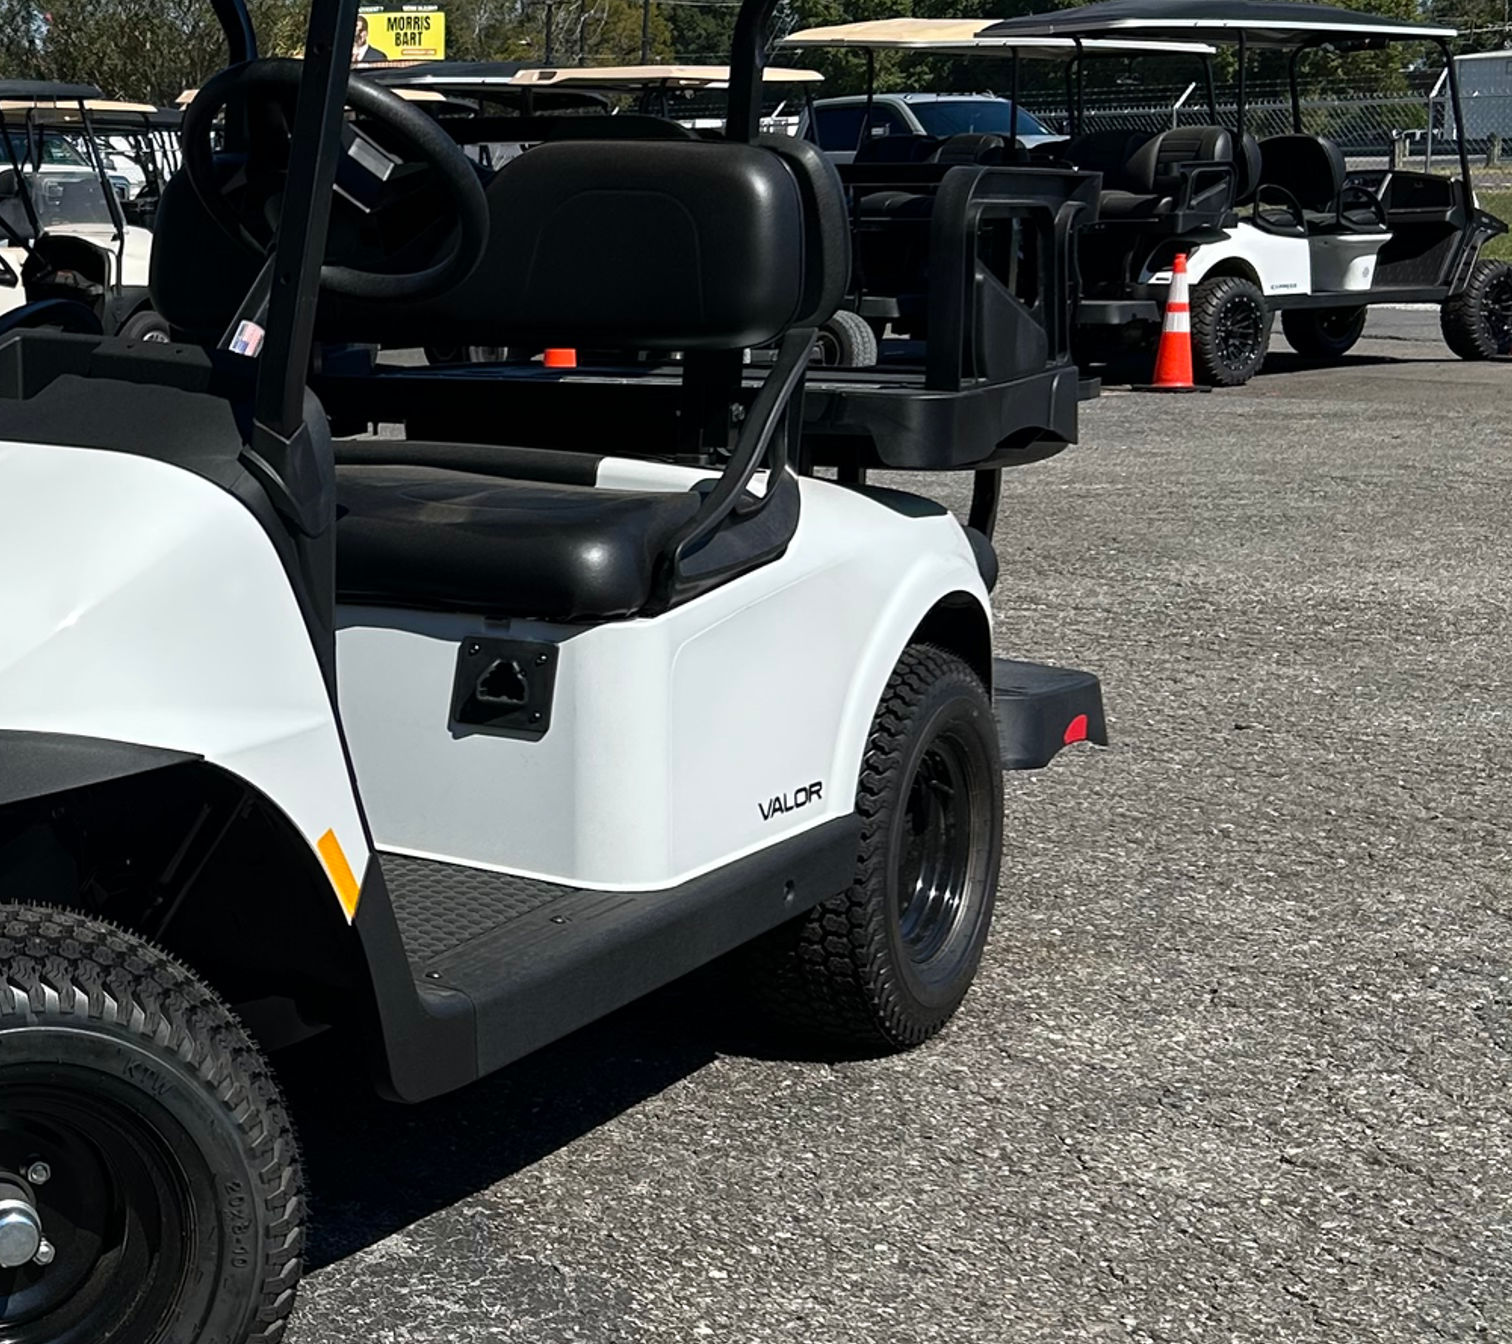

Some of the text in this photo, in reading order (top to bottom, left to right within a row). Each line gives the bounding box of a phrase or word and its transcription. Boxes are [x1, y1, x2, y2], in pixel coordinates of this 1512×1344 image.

[387, 16, 431, 32] MORRIS
[395, 32, 423, 47] BART
[758, 780, 823, 821] VALOR
